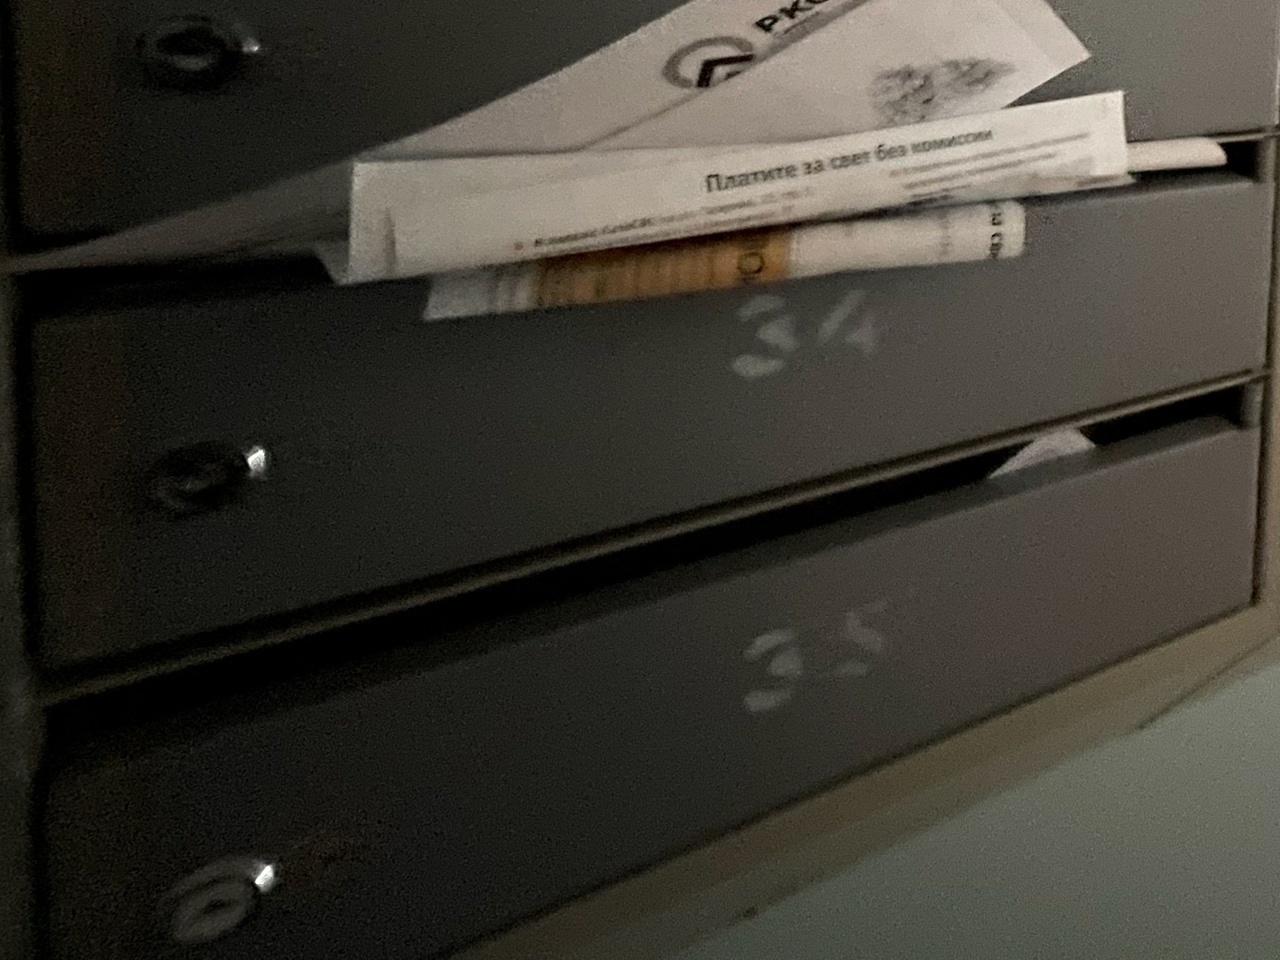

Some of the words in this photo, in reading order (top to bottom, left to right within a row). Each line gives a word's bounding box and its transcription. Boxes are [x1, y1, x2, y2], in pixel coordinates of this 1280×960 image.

[705, 163, 798, 194] Платите
[802, 158, 826, 176] за
[829, 150, 871, 171] свет
[875, 142, 907, 161] без
[910, 129, 993, 155] комиссии
[732, 289, 878, 379] 34
